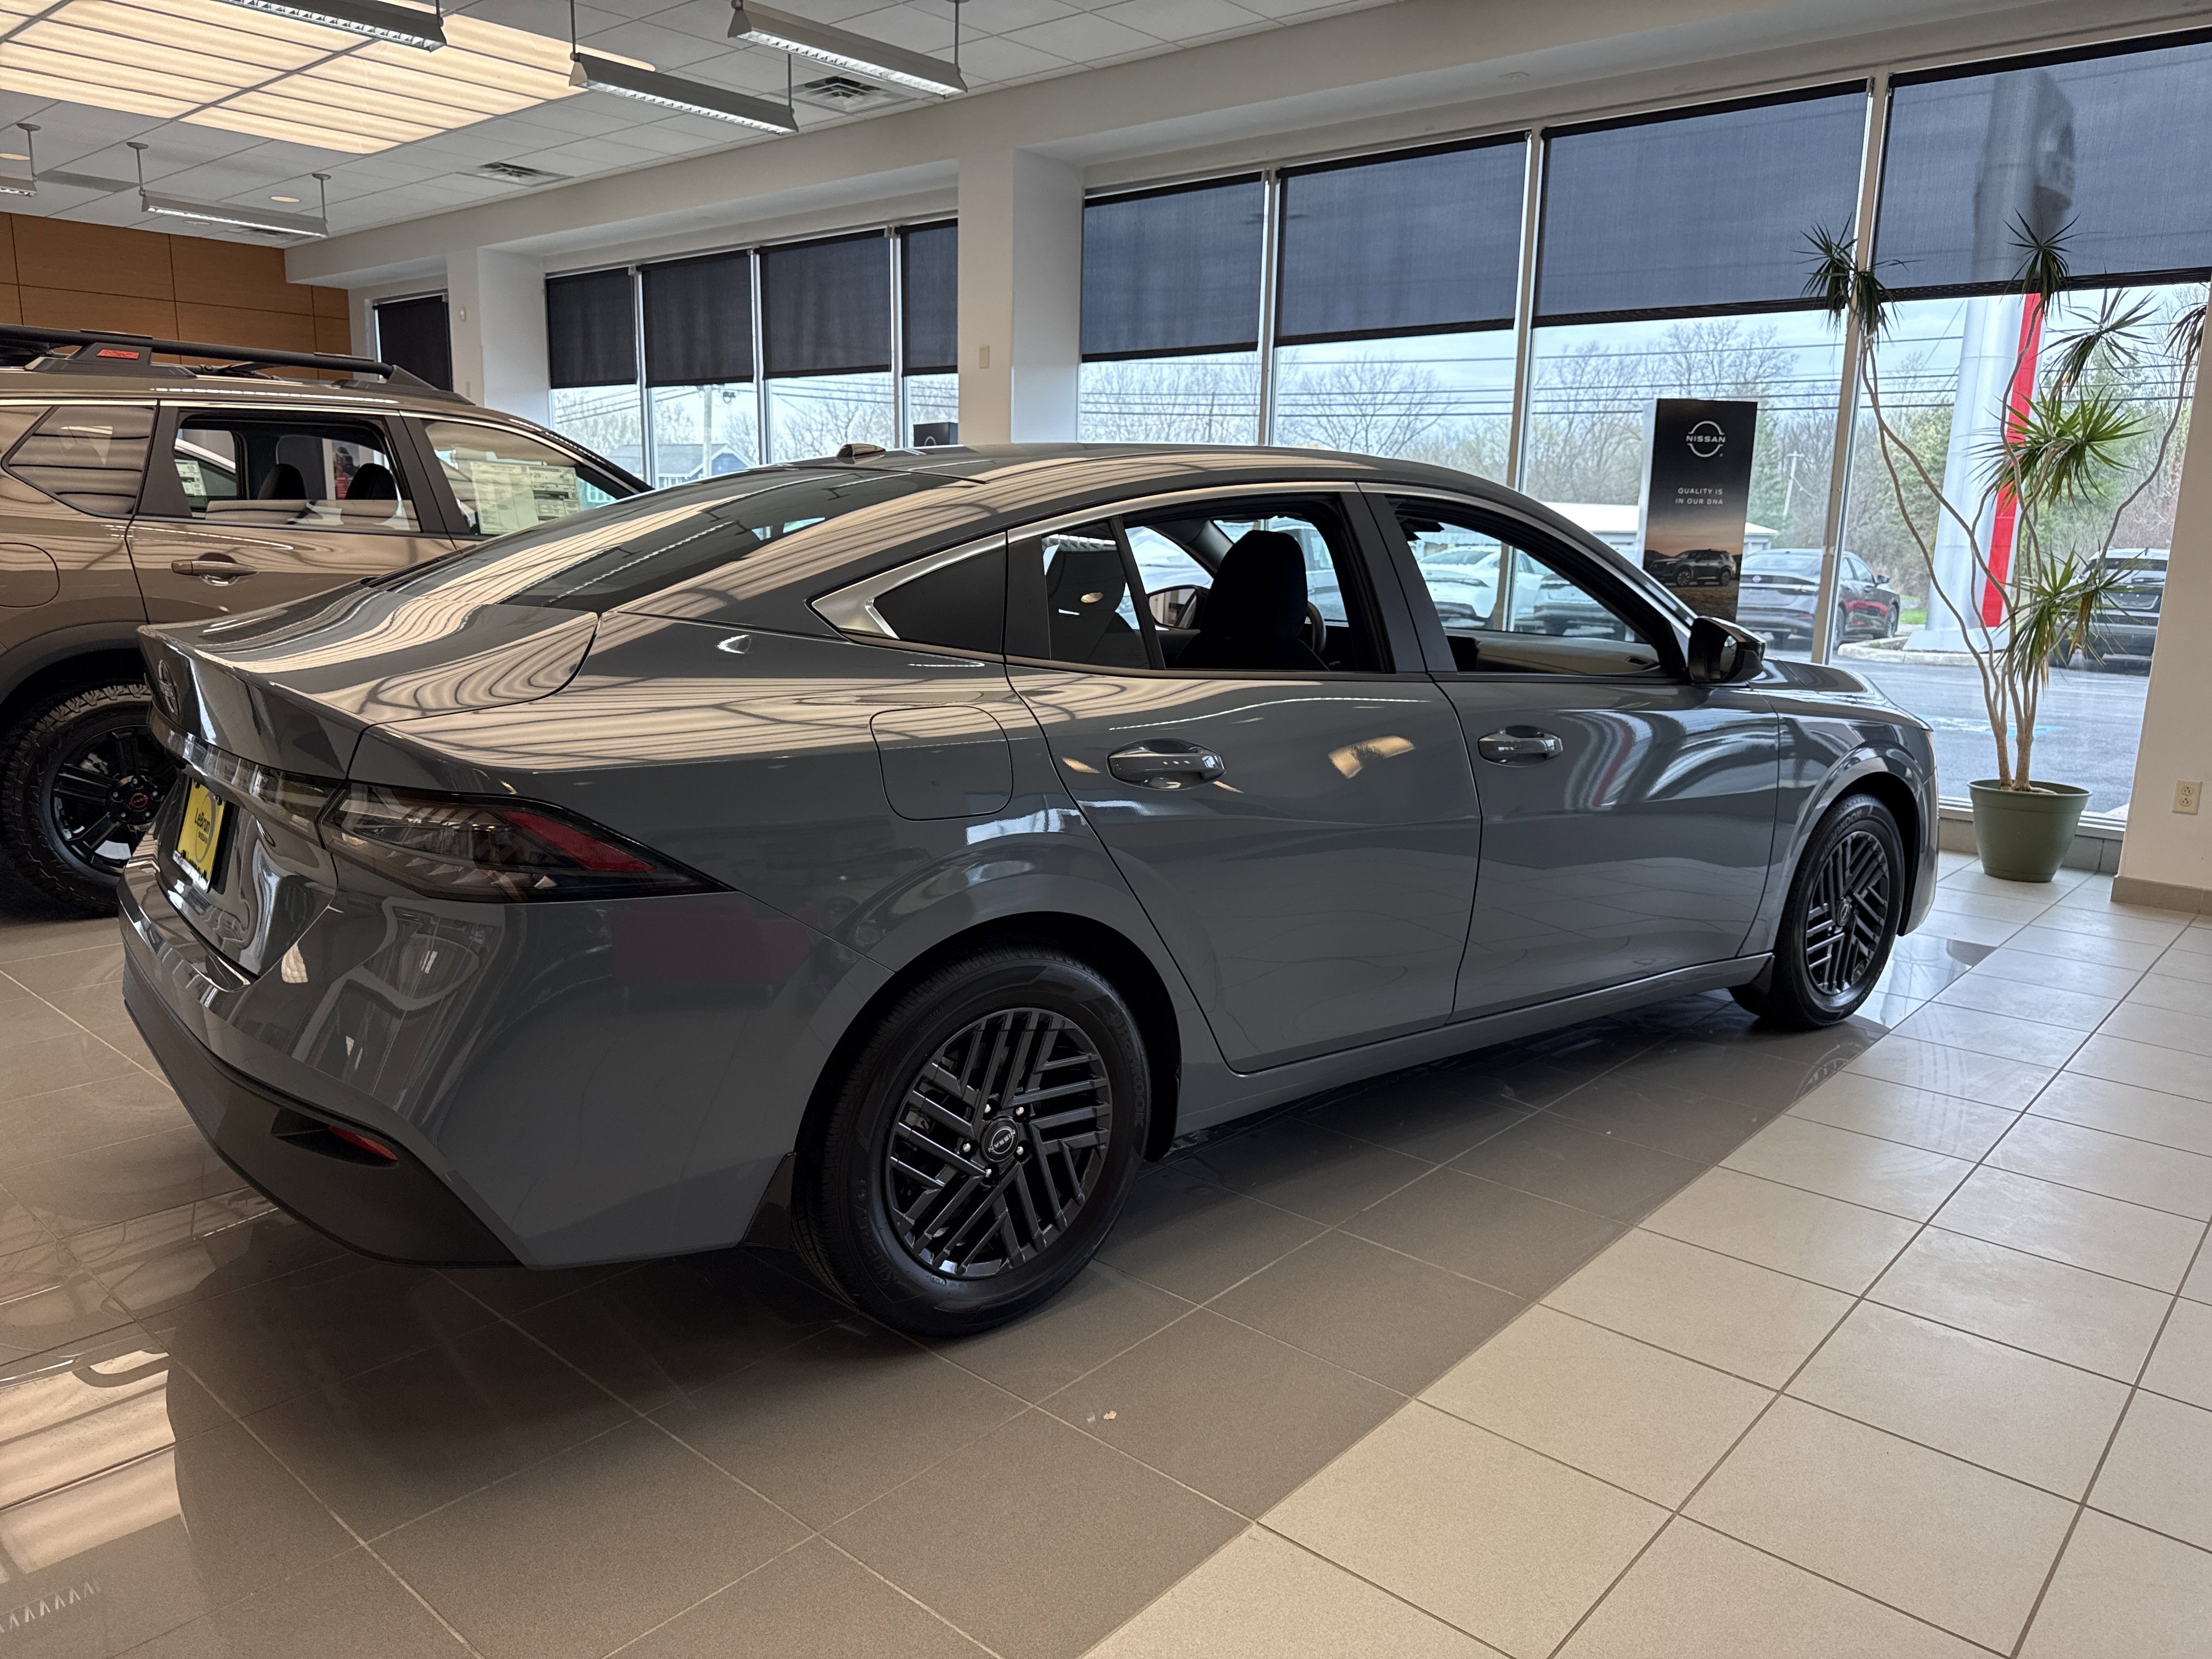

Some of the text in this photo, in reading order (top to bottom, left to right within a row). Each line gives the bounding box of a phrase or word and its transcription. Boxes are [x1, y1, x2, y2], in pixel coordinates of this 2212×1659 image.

[1685, 435, 1726, 443] NISSAN
[194, 807, 211, 834] LeBrun
[988, 1129, 1016, 1153] NISSAN
